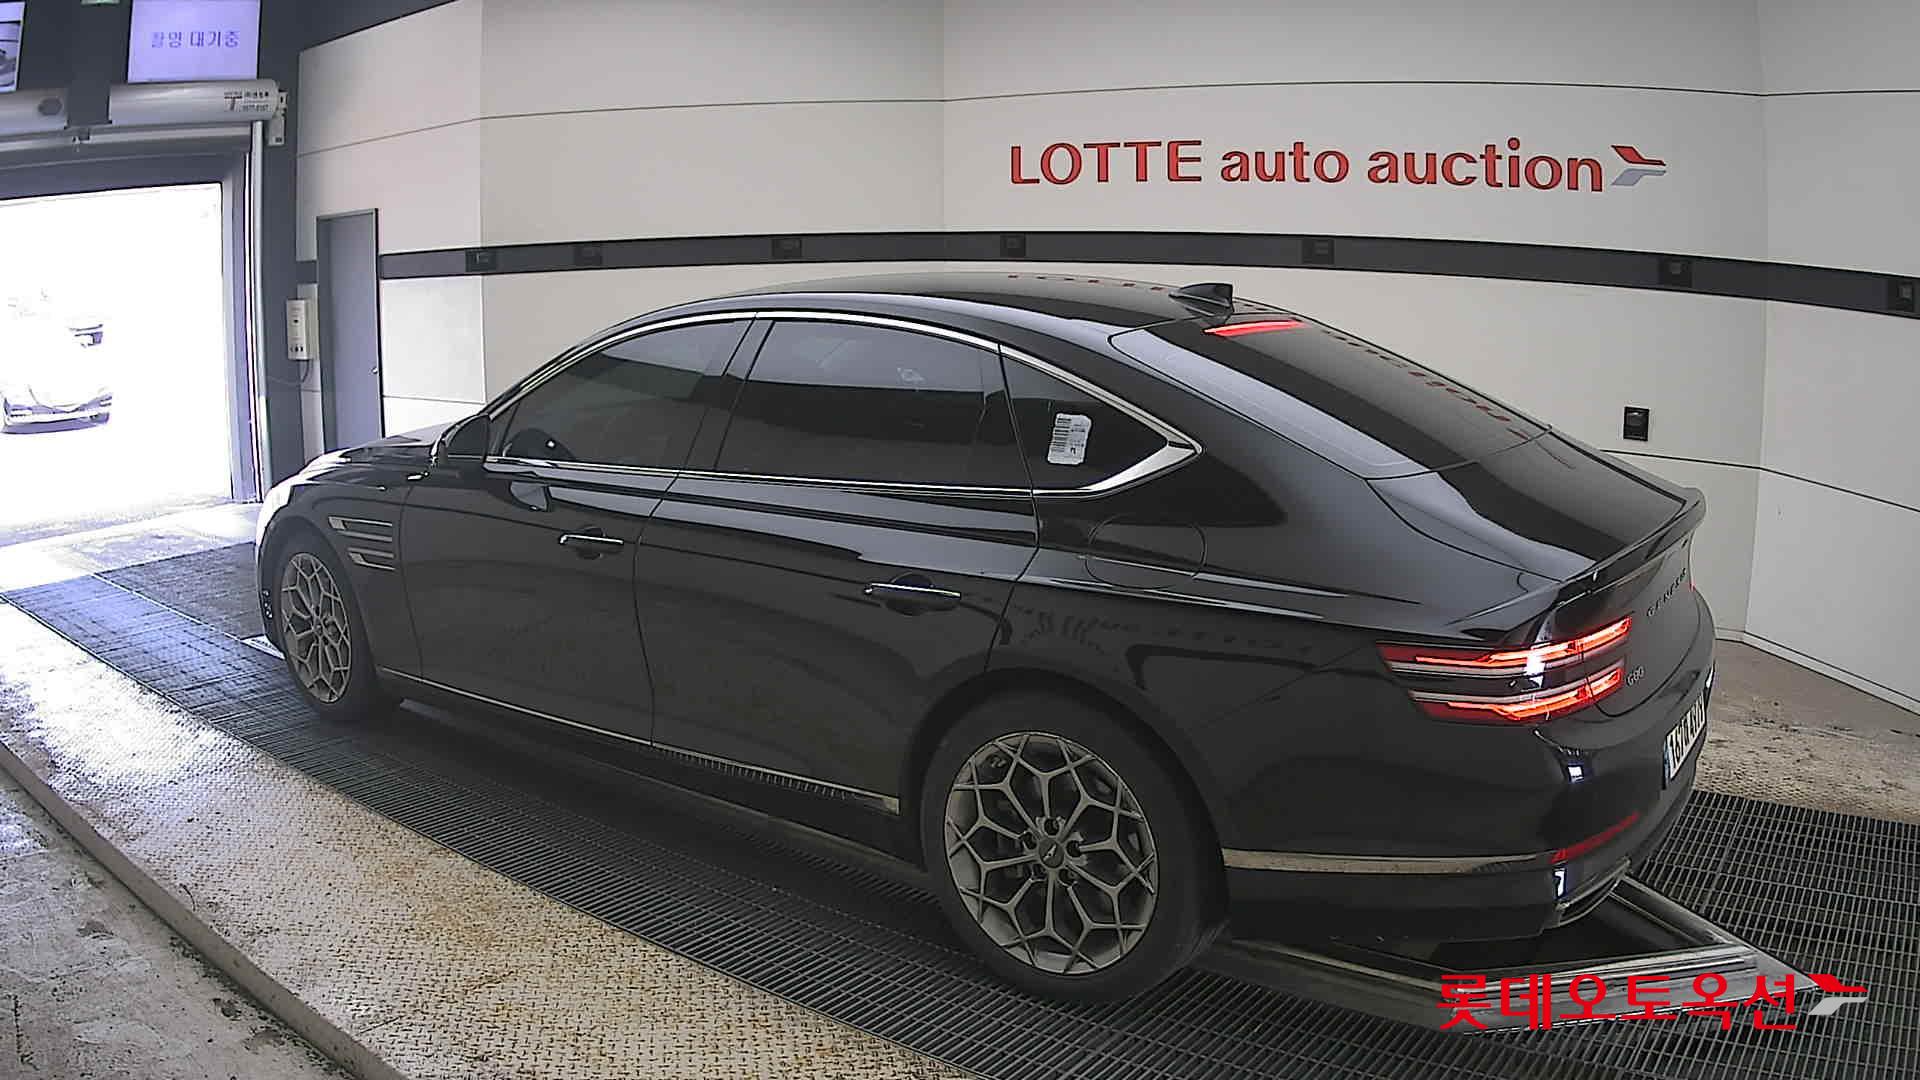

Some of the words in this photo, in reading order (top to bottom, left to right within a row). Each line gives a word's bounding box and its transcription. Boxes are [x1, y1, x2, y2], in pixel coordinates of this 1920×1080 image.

[190, 29, 241, 48] 대기중
[1010, 140, 1202, 185] LOTTE
[1220, 141, 1350, 183] auto
[1367, 137, 1603, 192] auction
